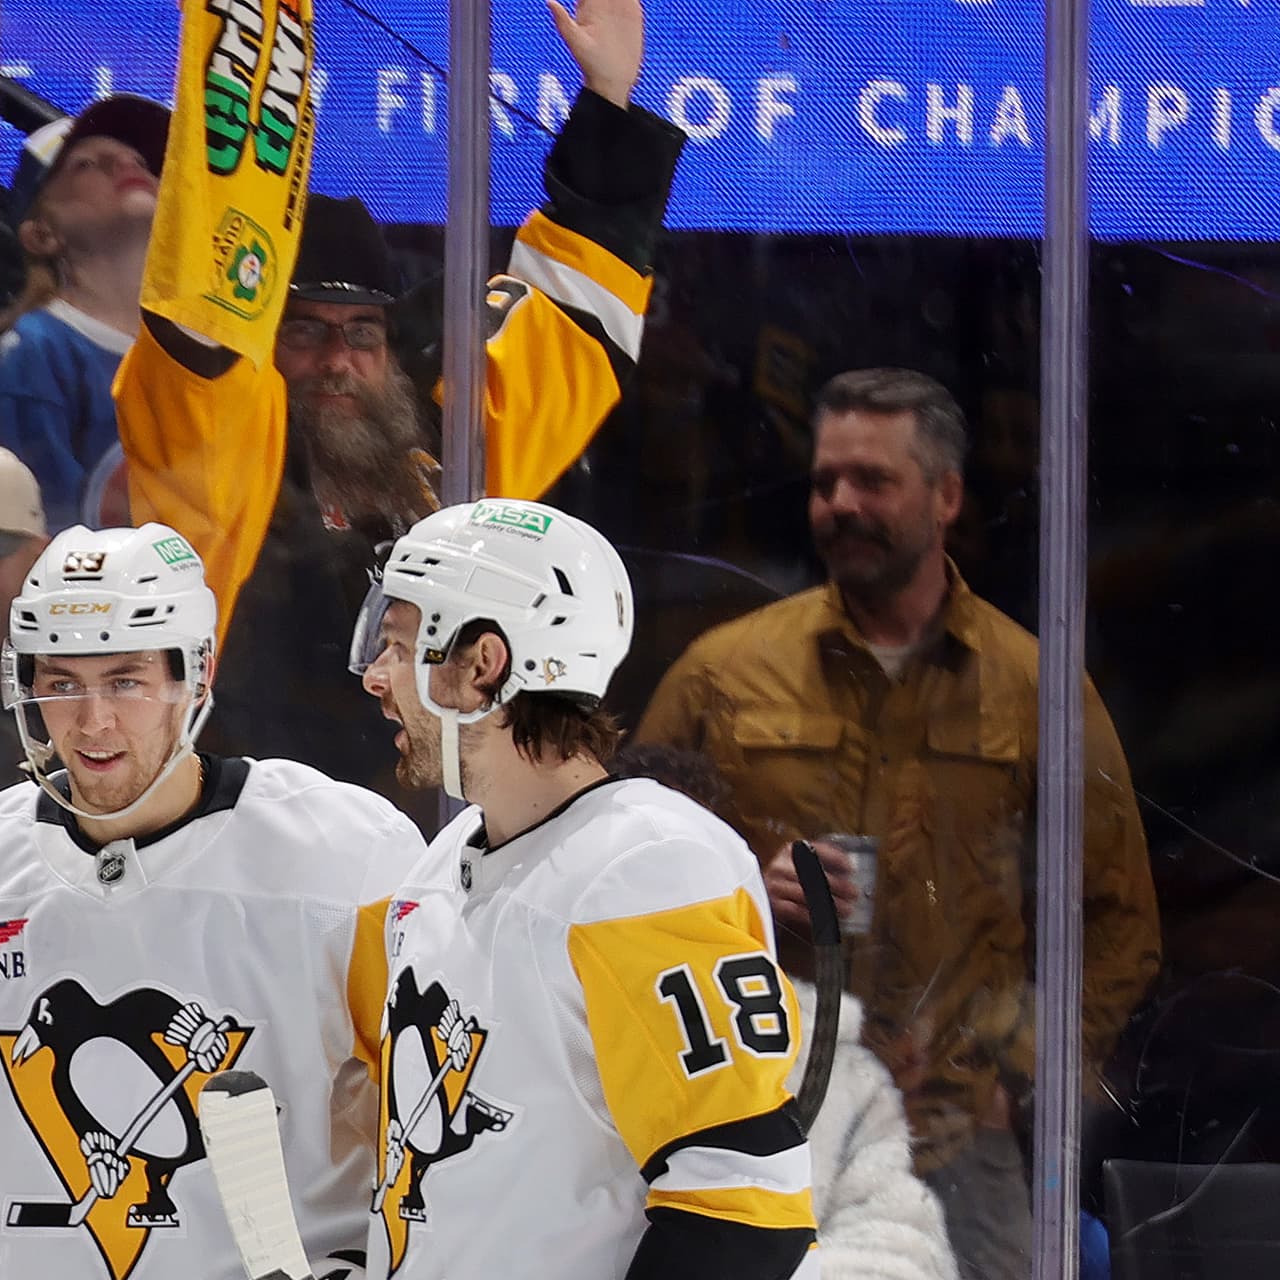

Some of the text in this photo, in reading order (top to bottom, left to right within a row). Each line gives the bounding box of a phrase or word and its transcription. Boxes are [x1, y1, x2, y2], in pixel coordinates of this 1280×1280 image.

[669, 72, 800, 143] OF
[472, 503, 547, 533] MSA
[506, 525, 544, 543] Company
[48, 602, 112, 615] CCM
[654, 950, 794, 1081] 18
